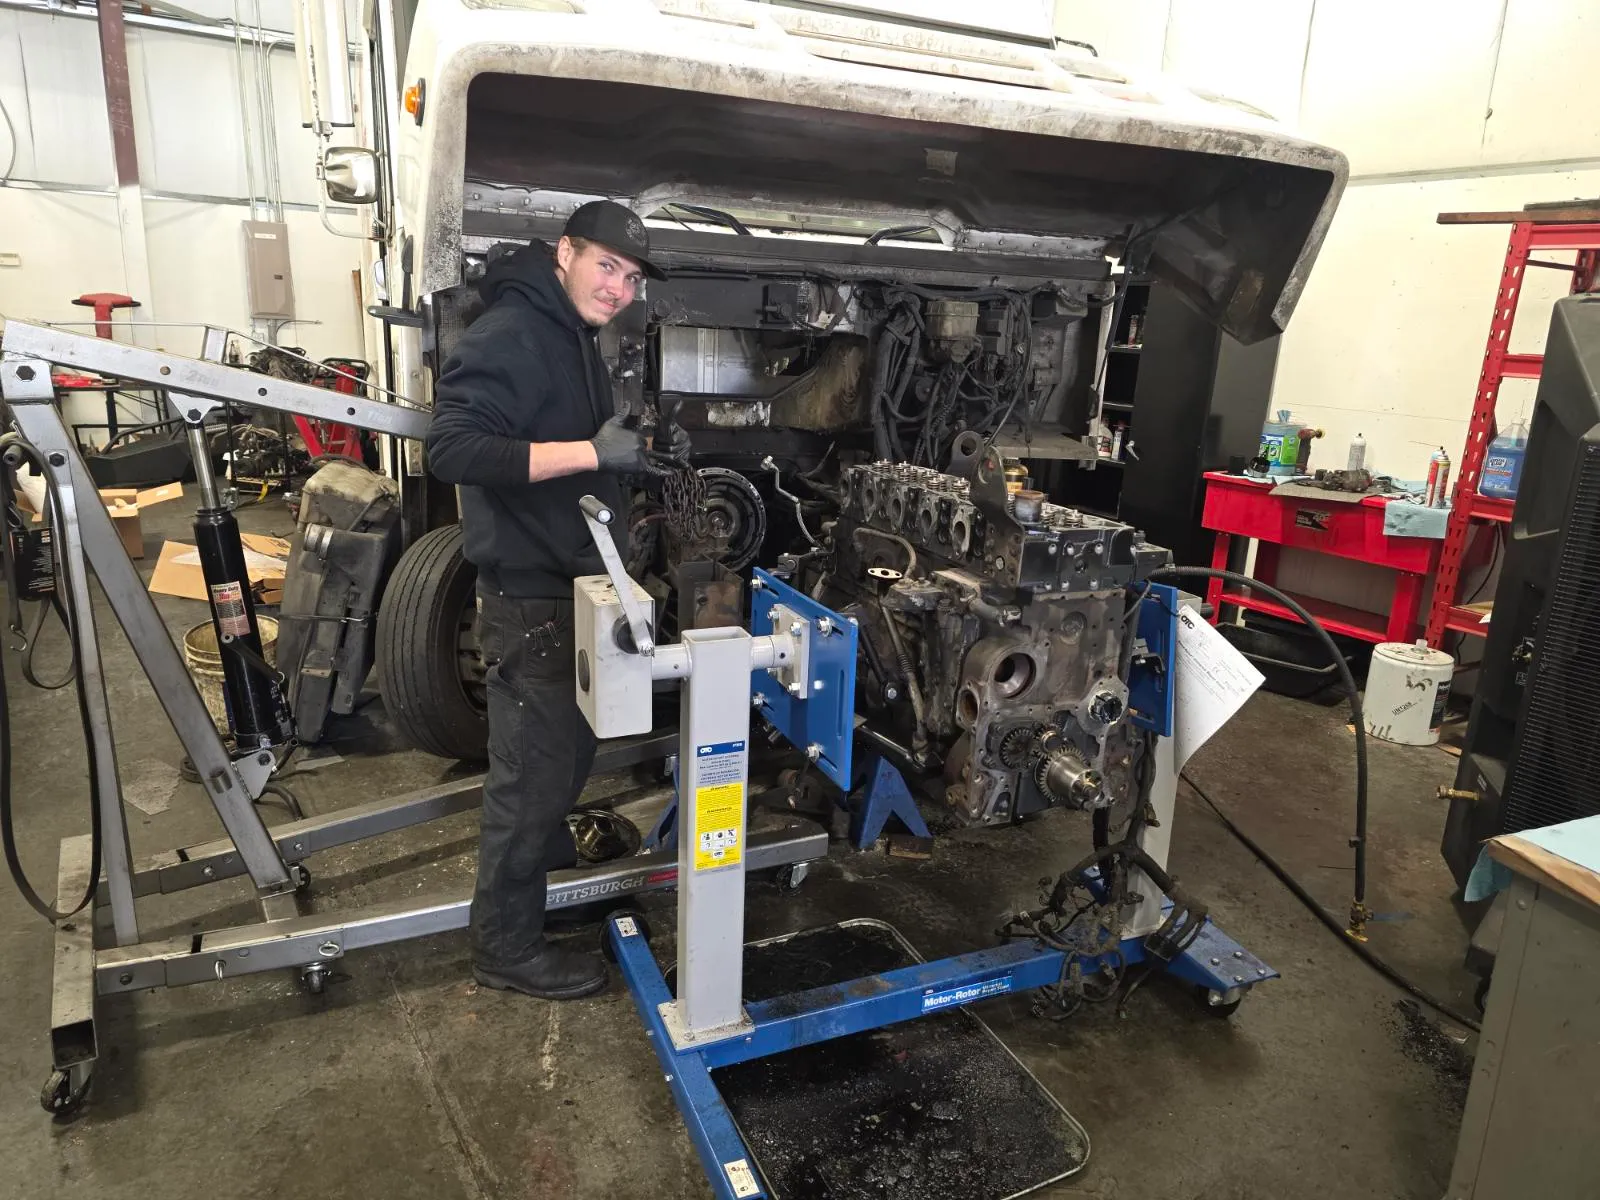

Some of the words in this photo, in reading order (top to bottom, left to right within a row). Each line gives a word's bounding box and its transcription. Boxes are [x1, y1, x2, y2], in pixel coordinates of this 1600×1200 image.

[1181, 615, 1195, 630] OTC
[700, 746, 713, 754] OTC
[546, 875, 645, 906] PITTSBURGH
[924, 988, 981, 1007] Motor-Rotor
